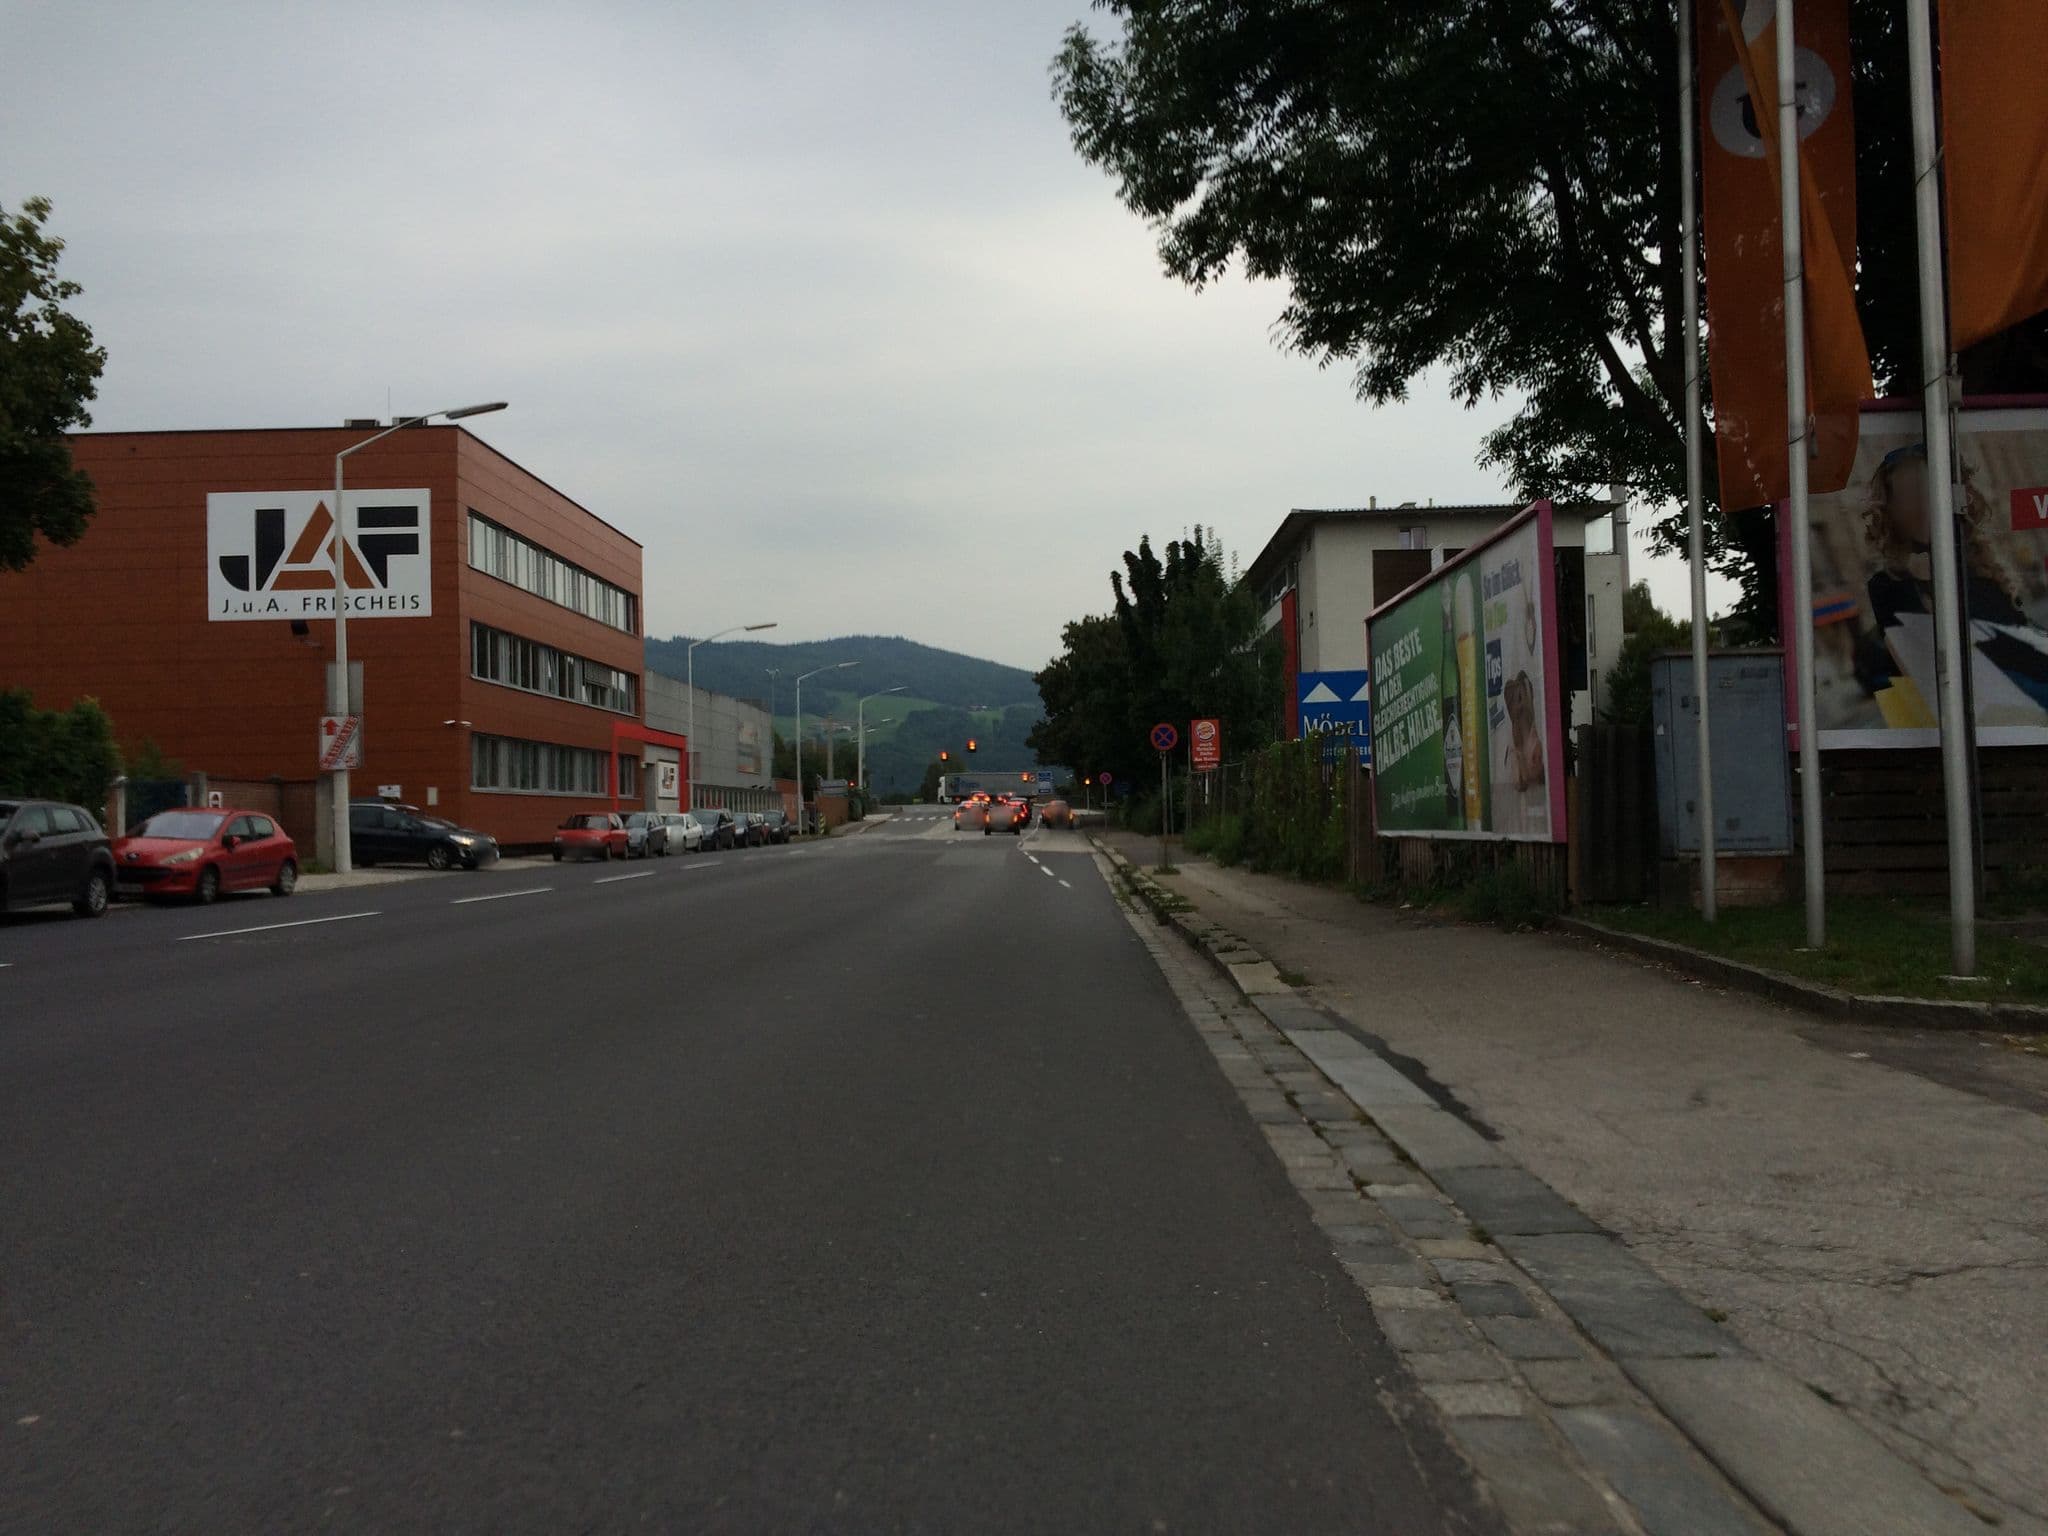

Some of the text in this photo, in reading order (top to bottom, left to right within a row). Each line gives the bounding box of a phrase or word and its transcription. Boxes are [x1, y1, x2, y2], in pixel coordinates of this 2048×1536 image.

[219, 500, 419, 591] JAF
[1375, 627, 1422, 685] DAS BESTE
[1487, 655, 1502, 687] Tips
